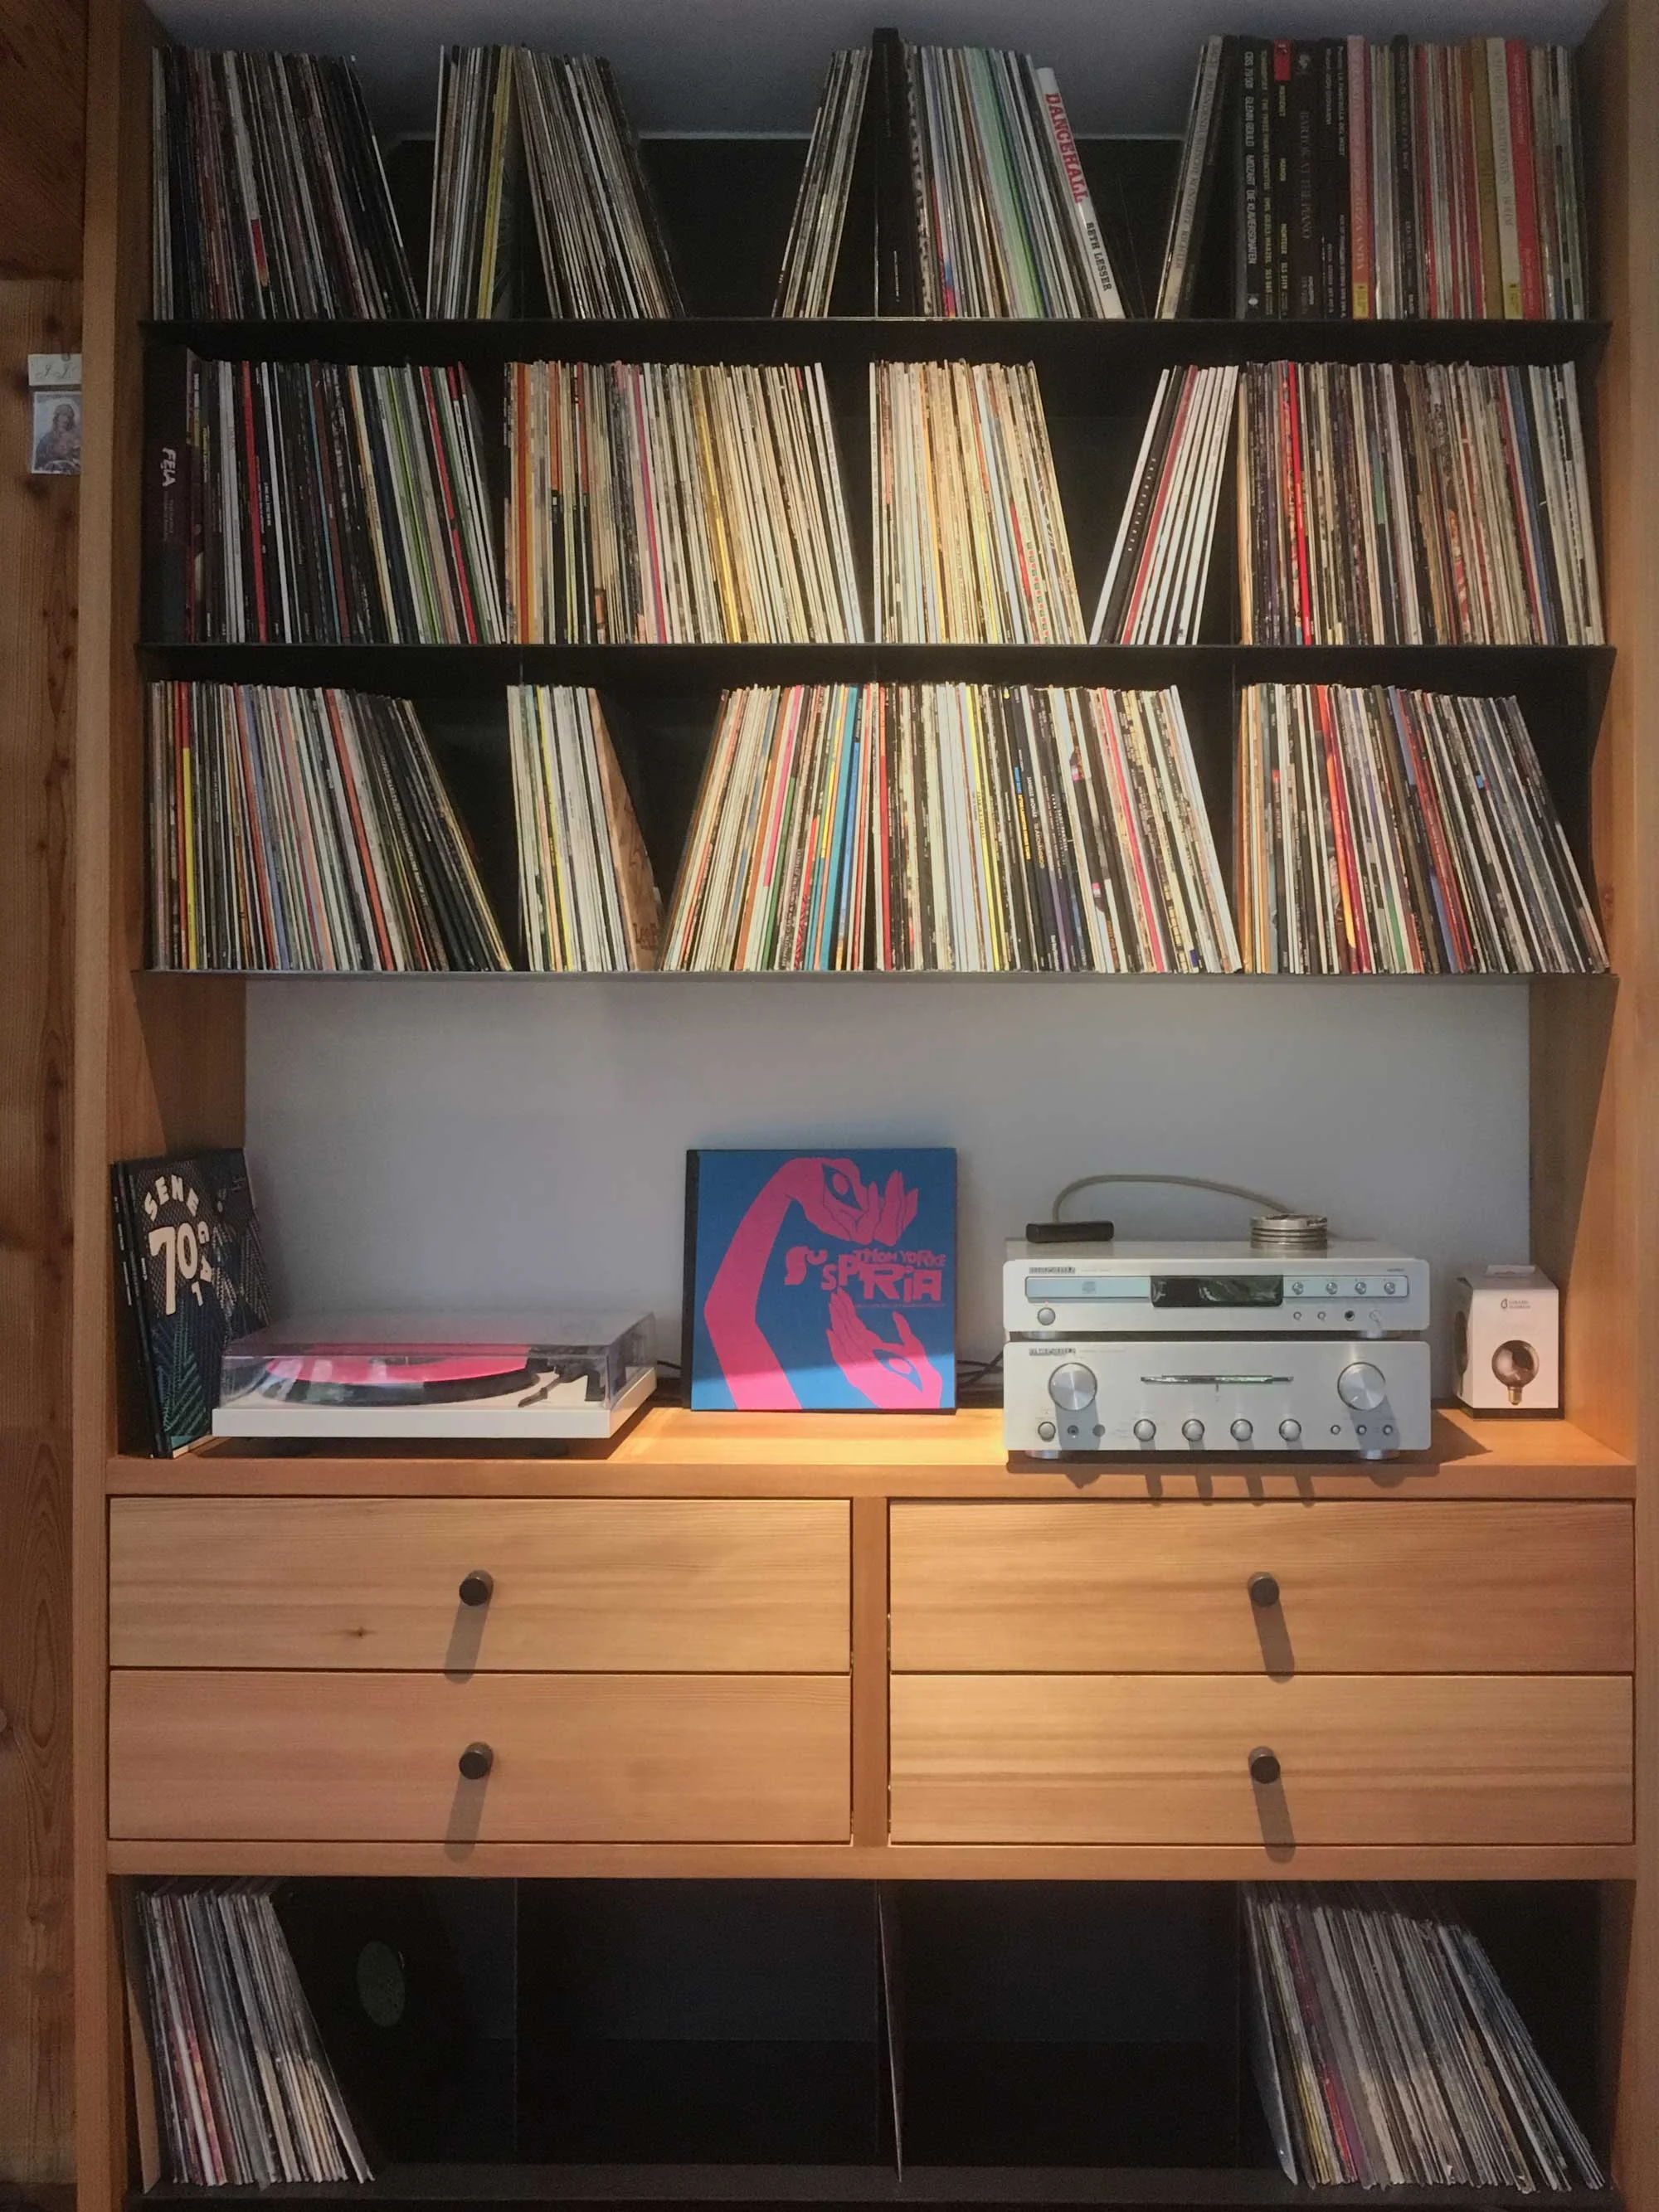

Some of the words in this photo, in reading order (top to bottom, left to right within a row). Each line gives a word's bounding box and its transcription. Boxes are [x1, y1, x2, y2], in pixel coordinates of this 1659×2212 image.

[1044, 93, 1090, 205] DANCEHALL
[1245, 122, 1255, 147] GOULD
[1086, 221, 1100, 250] BETH
[1093, 250, 1112, 292] LESSER
[148, 1222, 199, 1316] 70
